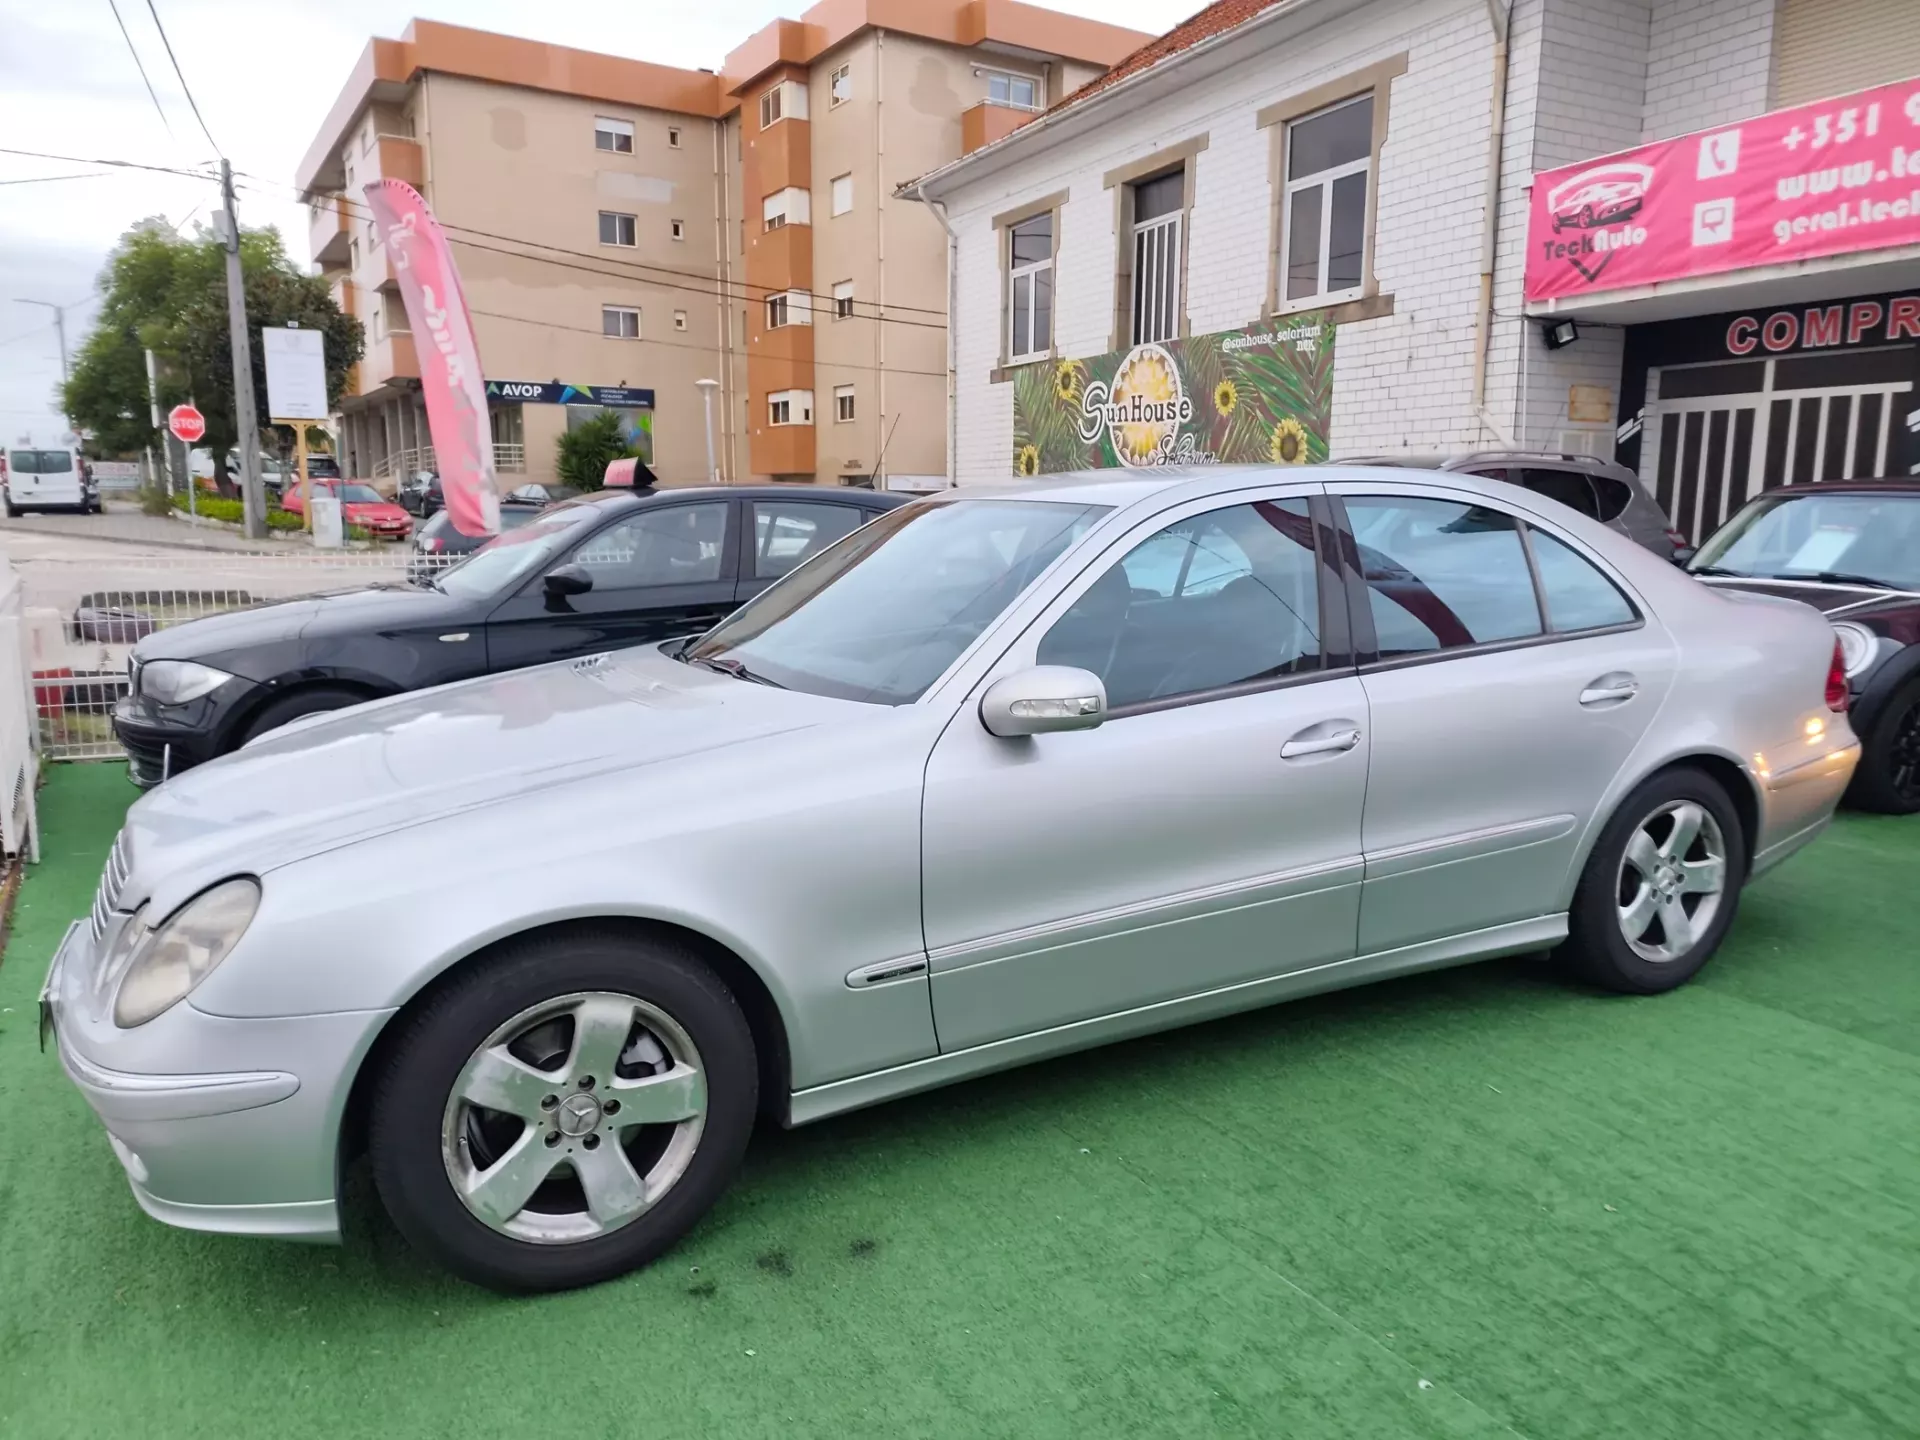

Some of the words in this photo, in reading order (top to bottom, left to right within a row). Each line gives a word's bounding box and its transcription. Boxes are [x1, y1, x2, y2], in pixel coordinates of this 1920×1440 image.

[1782, 102, 1880, 150] +351
[1726, 296, 1920, 355] COMPR
[502, 383, 542, 397] AVOP
[1078, 381, 1192, 444] SunHouse
[172, 417, 204, 430] STOP
